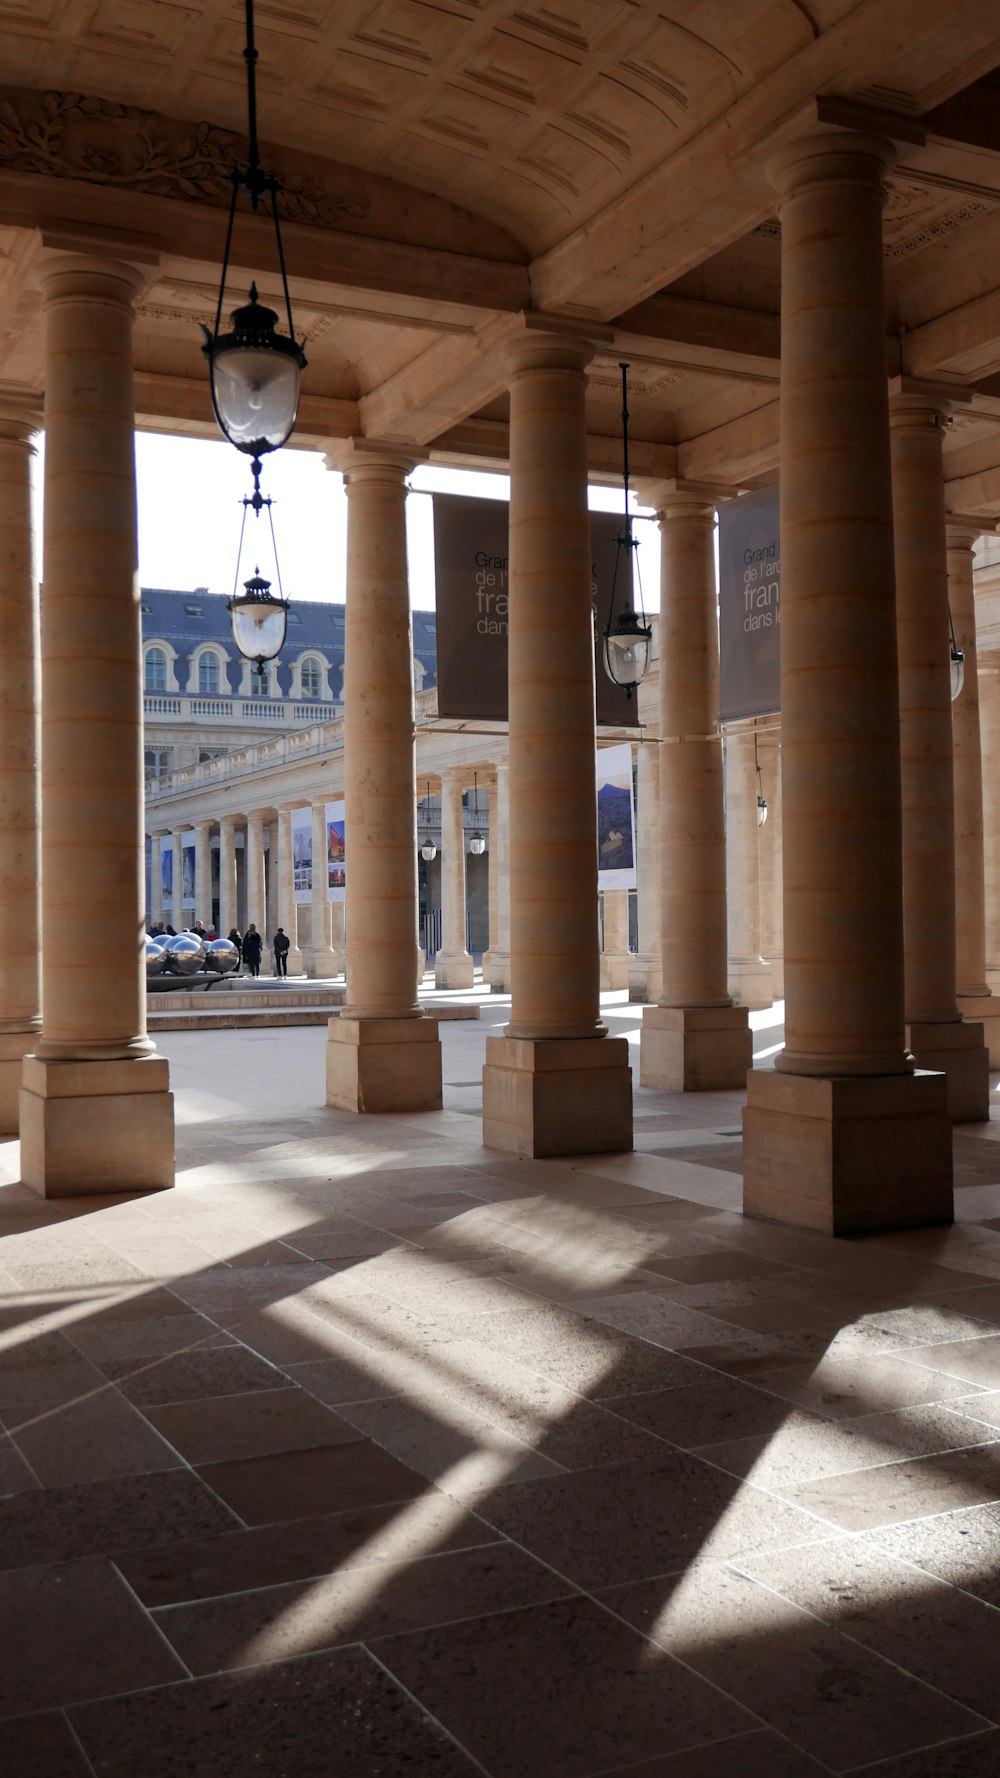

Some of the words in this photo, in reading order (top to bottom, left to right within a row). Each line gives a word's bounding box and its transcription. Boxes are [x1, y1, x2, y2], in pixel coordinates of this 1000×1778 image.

[743, 542, 776, 565] Grand
[475, 568, 496, 586] de
[743, 566, 758, 583] de
[743, 613, 773, 632] dans
